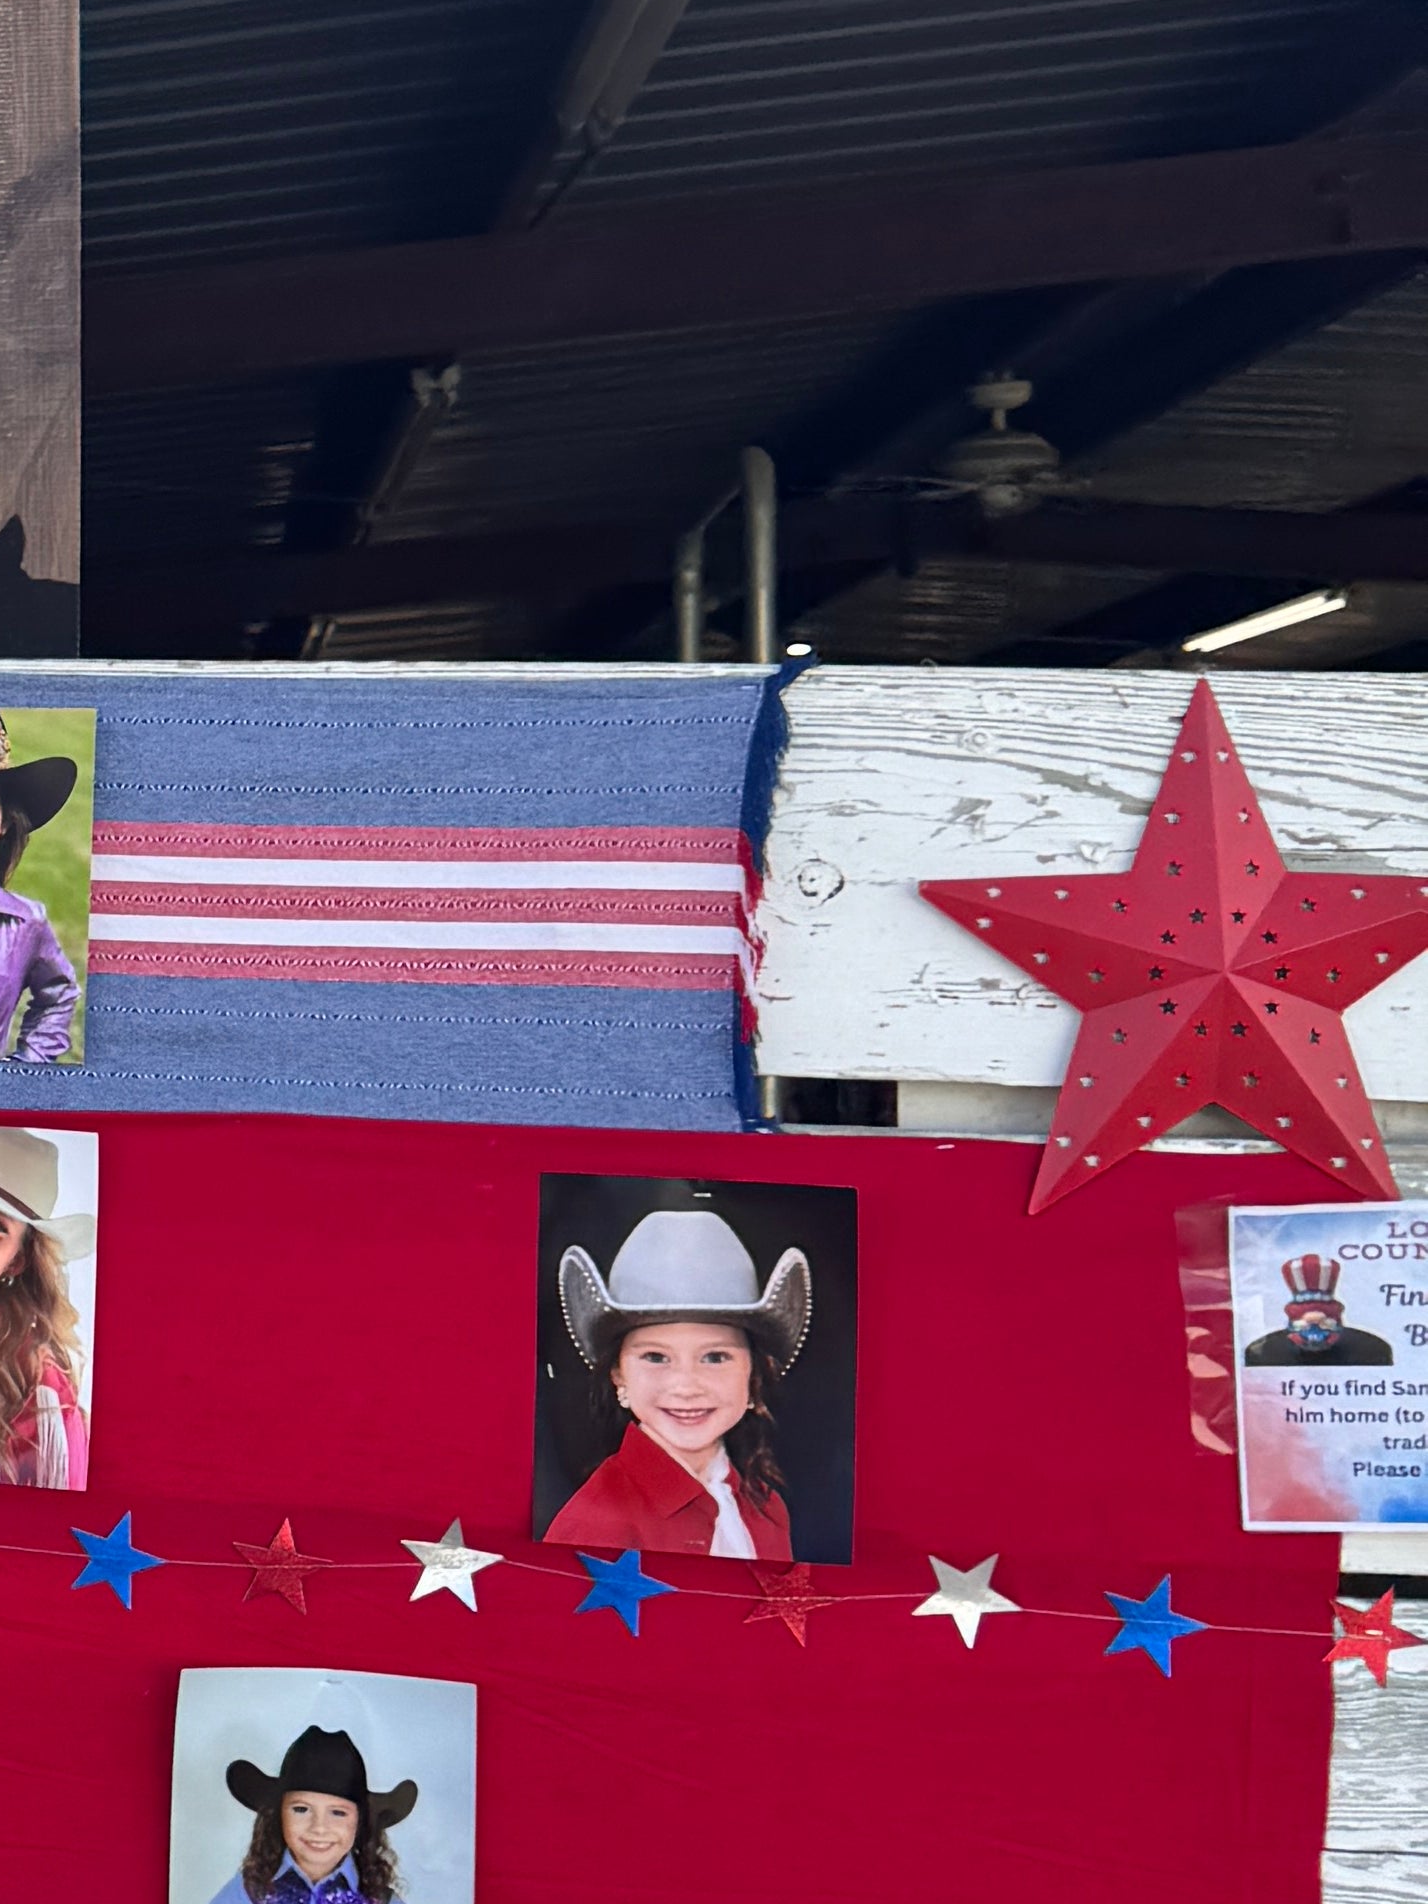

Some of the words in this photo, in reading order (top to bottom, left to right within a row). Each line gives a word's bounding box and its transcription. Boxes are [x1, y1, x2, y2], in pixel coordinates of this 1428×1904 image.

[1281, 1380, 1295, 1396] If
[1300, 1383, 1339, 1400] you
[1344, 1380, 1385, 1396] find
[1285, 1407, 1324, 1423] him
[1330, 1408, 1389, 1423] home
[1395, 1407, 1425, 1424] (to
[1353, 1462, 1421, 1477] Please
